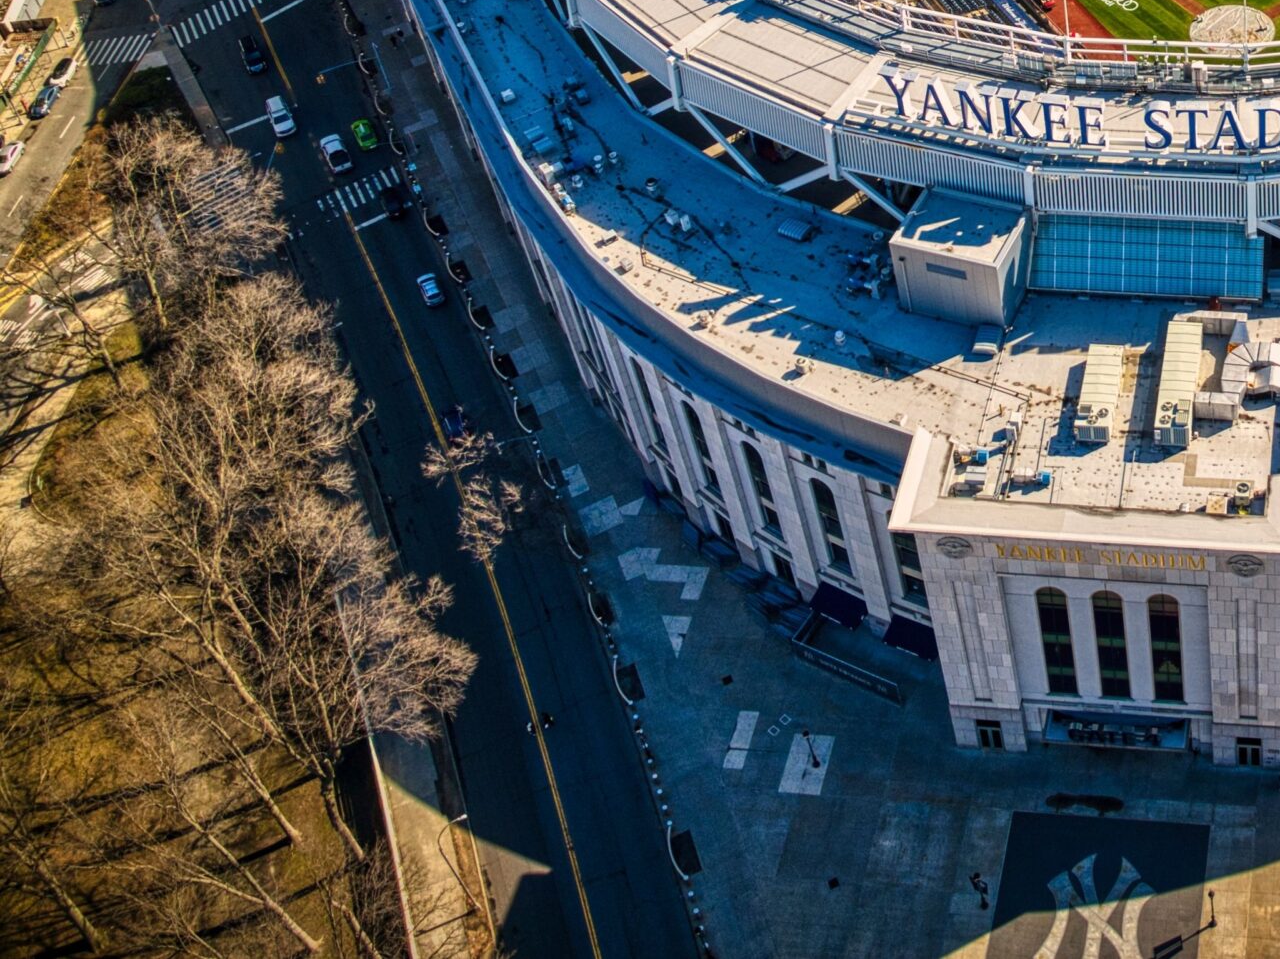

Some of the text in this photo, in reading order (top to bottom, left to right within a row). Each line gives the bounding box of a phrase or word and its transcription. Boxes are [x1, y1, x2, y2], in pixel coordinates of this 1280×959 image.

[880, 70, 1107, 147] YANKEE
[995, 544, 1206, 571] YANKEE STADIUM
